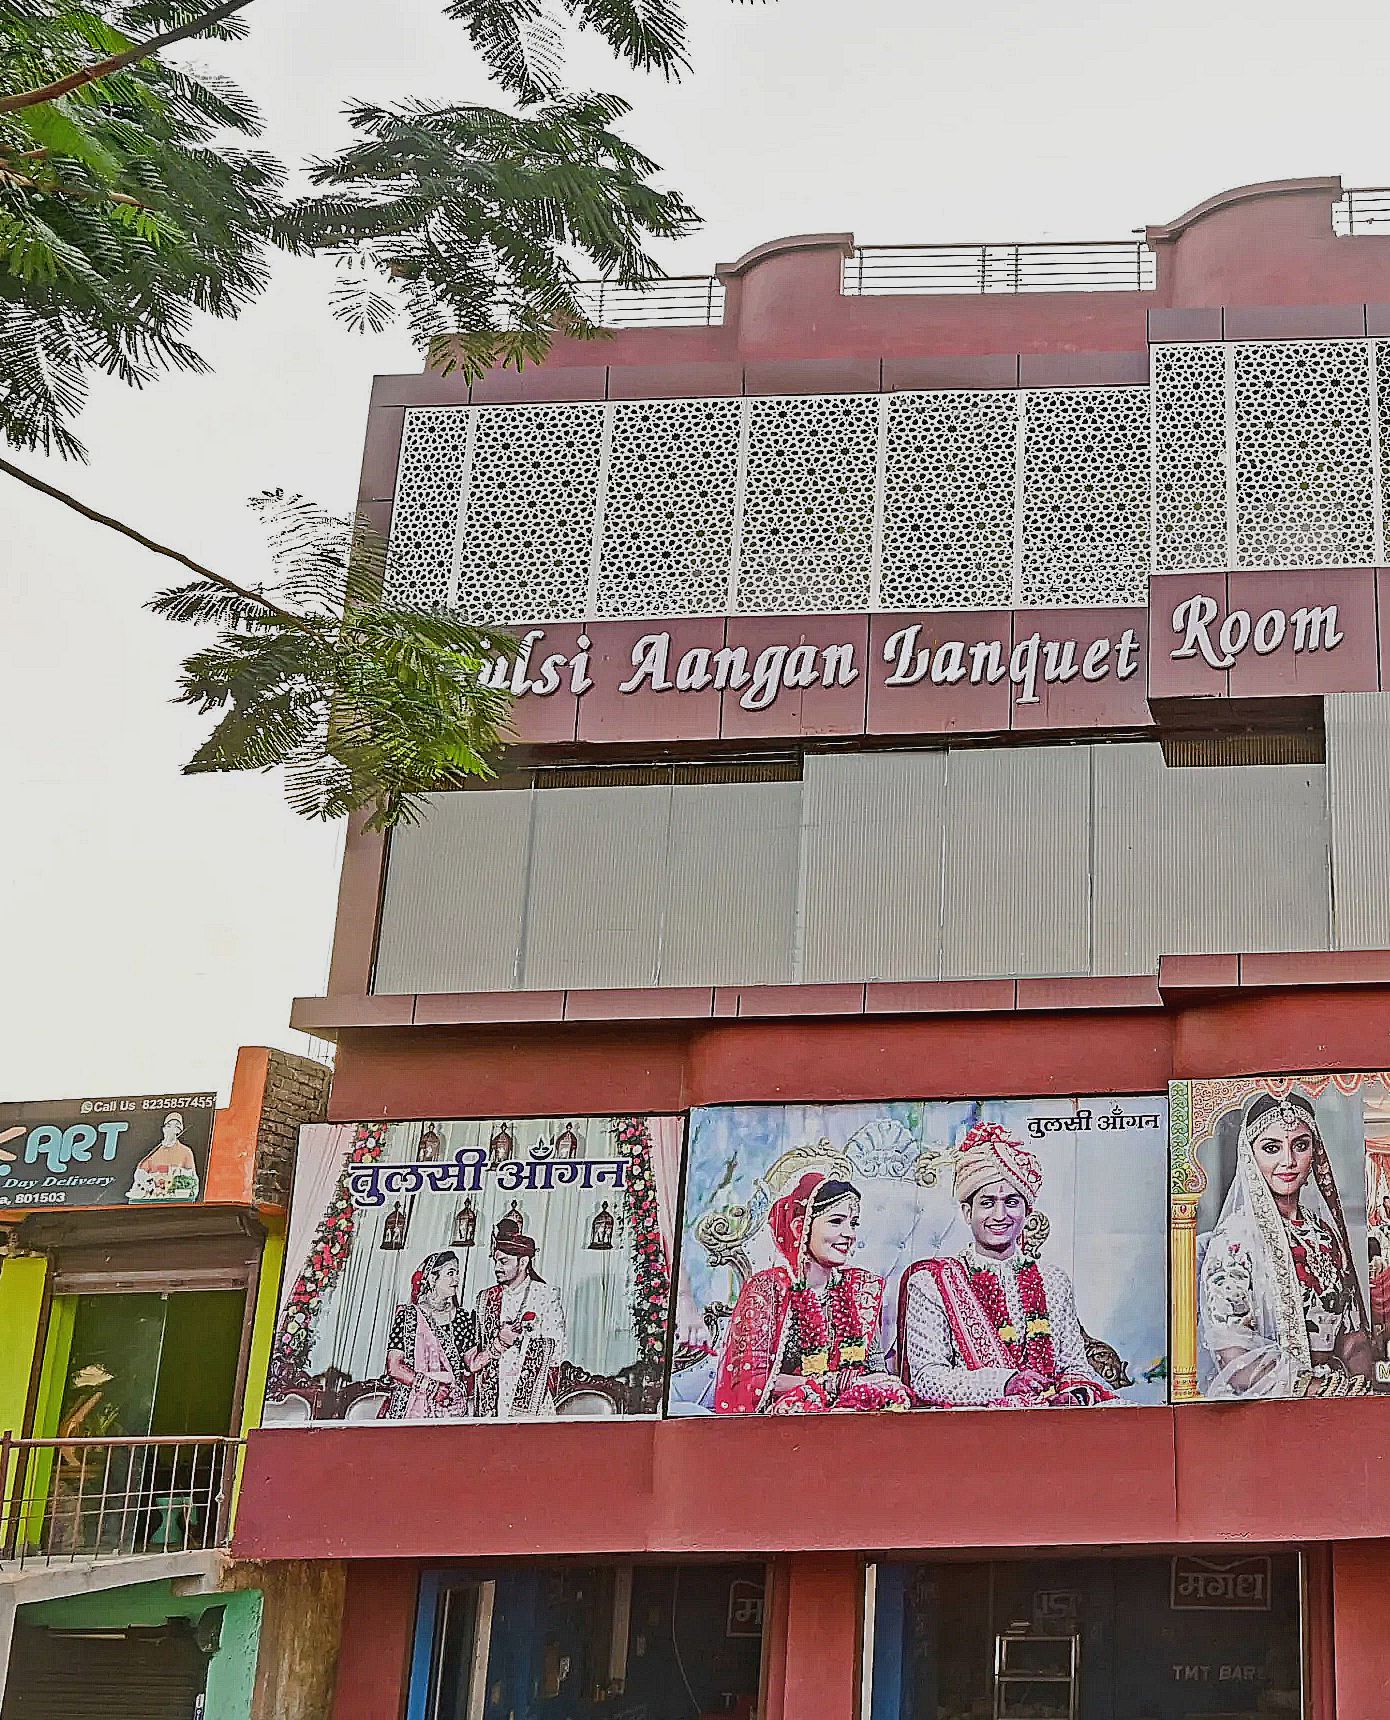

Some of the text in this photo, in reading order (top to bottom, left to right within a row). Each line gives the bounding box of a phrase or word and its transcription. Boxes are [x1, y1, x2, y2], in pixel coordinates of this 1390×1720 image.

[445, 629, 593, 697] ulsi
[618, 631, 860, 711] Aangan
[1171, 593, 1344, 669] Room
[93, 1101, 116, 1112] Call
[120, 1101, 136, 1111] Us
[1027, 1109, 1092, 1138] तुलसी
[41, 1176, 115, 1187] Delivery
[350, 1149, 488, 1206] तुलसी
[1172, 1665, 1209, 1681] TMT
